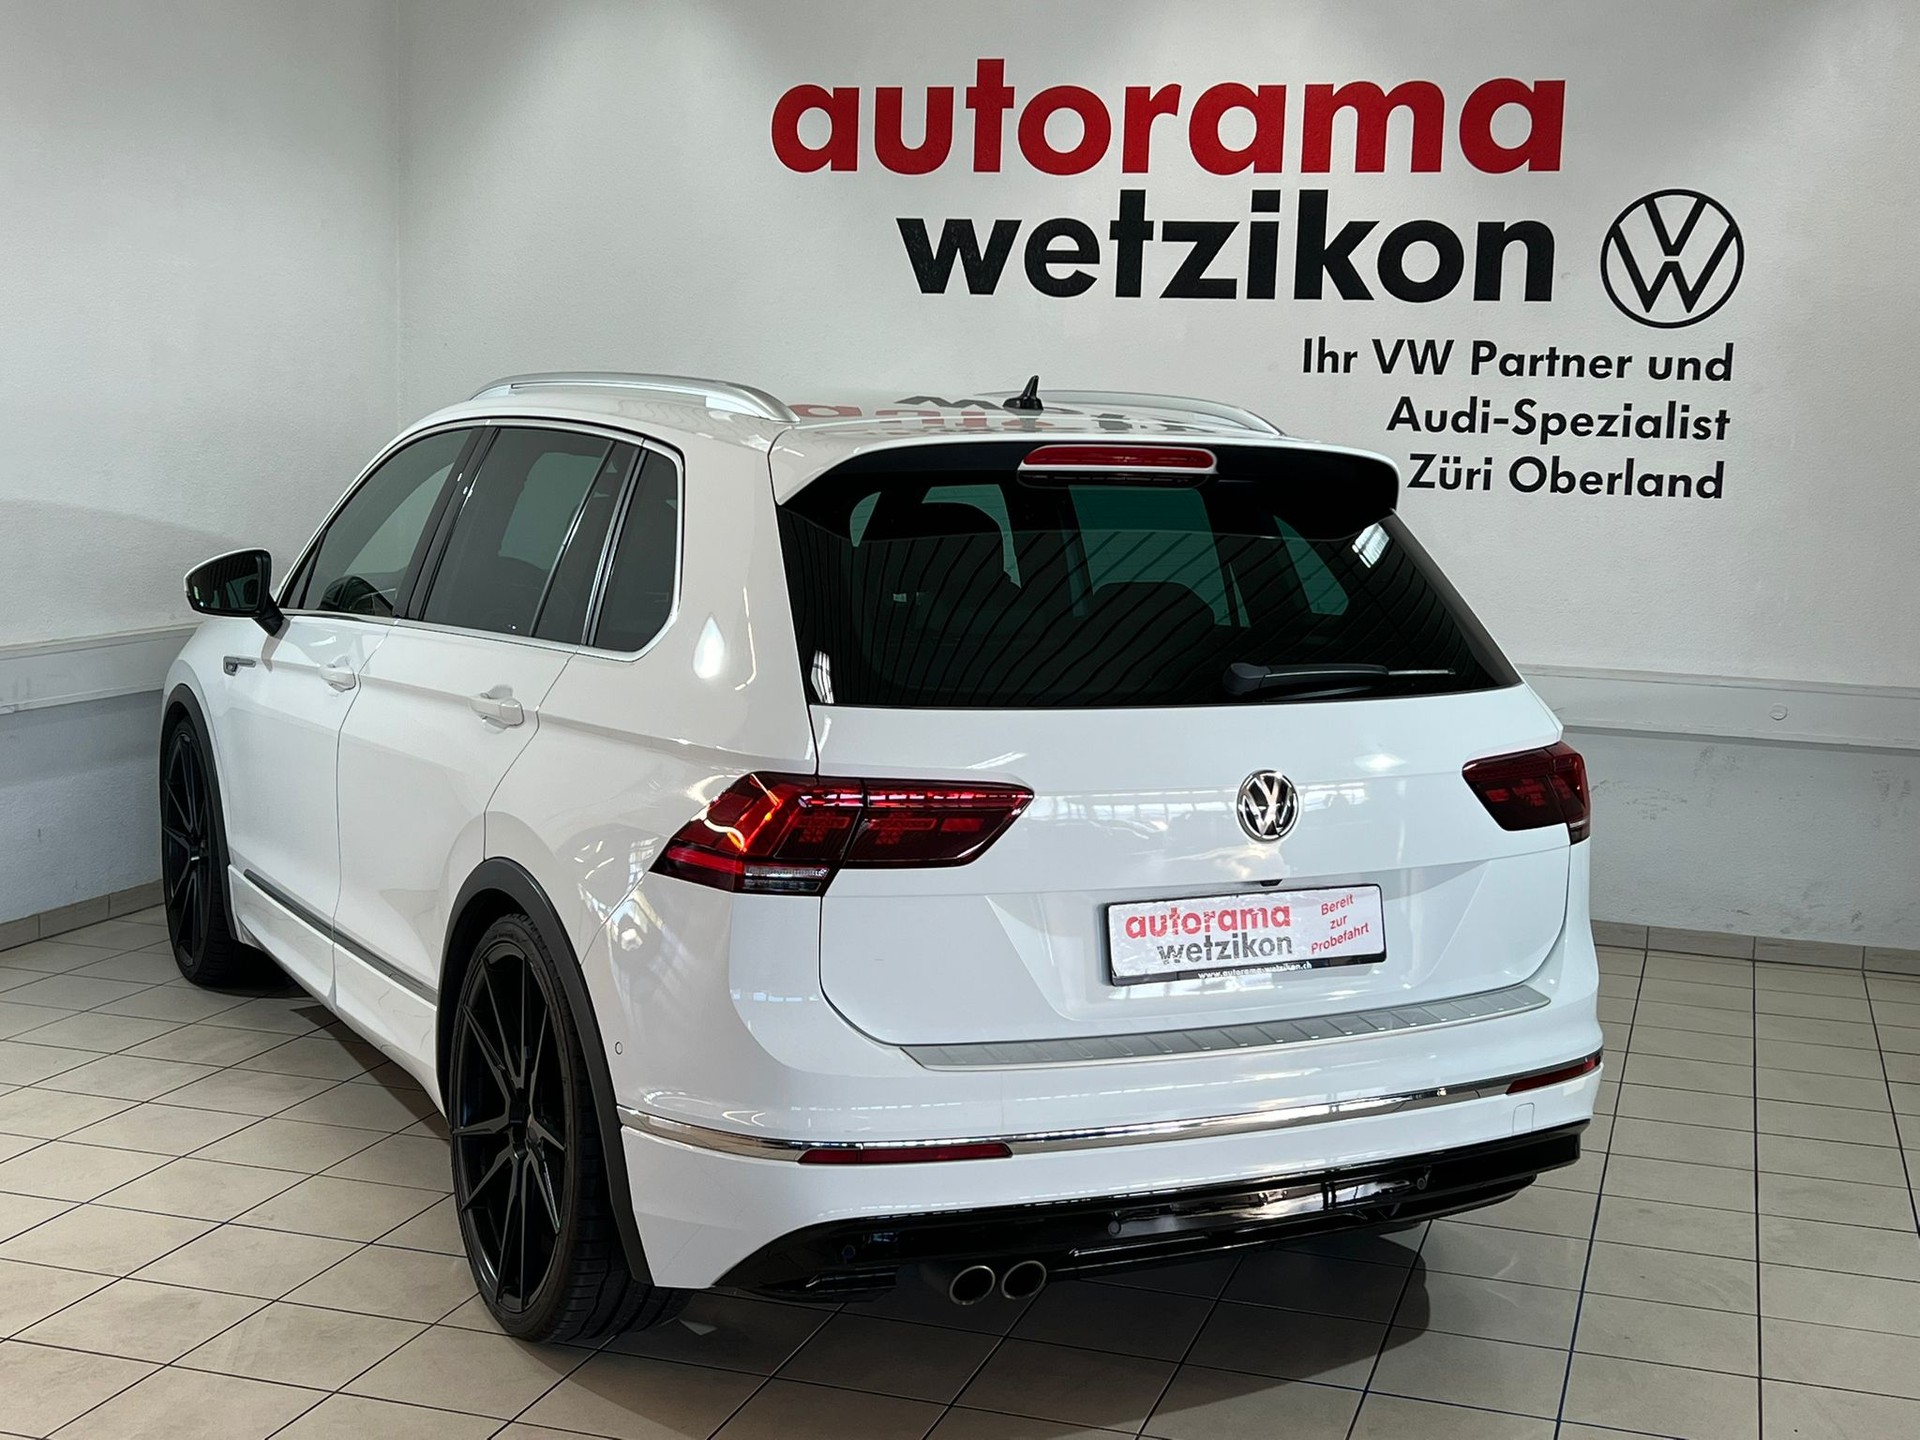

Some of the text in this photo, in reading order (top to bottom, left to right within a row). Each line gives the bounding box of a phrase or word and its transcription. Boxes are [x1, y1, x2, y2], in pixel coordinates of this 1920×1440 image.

[772, 59, 1565, 176] autorama
[896, 189, 1555, 304] wetzikon
[1601, 188, 1744, 328] VW
[1302, 336, 1734, 382] Ihr VW Partner und
[1387, 395, 1731, 443] Audi-Spezialist
[1406, 453, 1725, 499] Züri Oberland
[1125, 904, 1291, 939] autorama
[1320, 893, 1355, 917] Bereit
[1329, 913, 1348, 930] zur
[1156, 931, 1293, 965] wetzikon
[1310, 921, 1370, 955] Probefahrt
